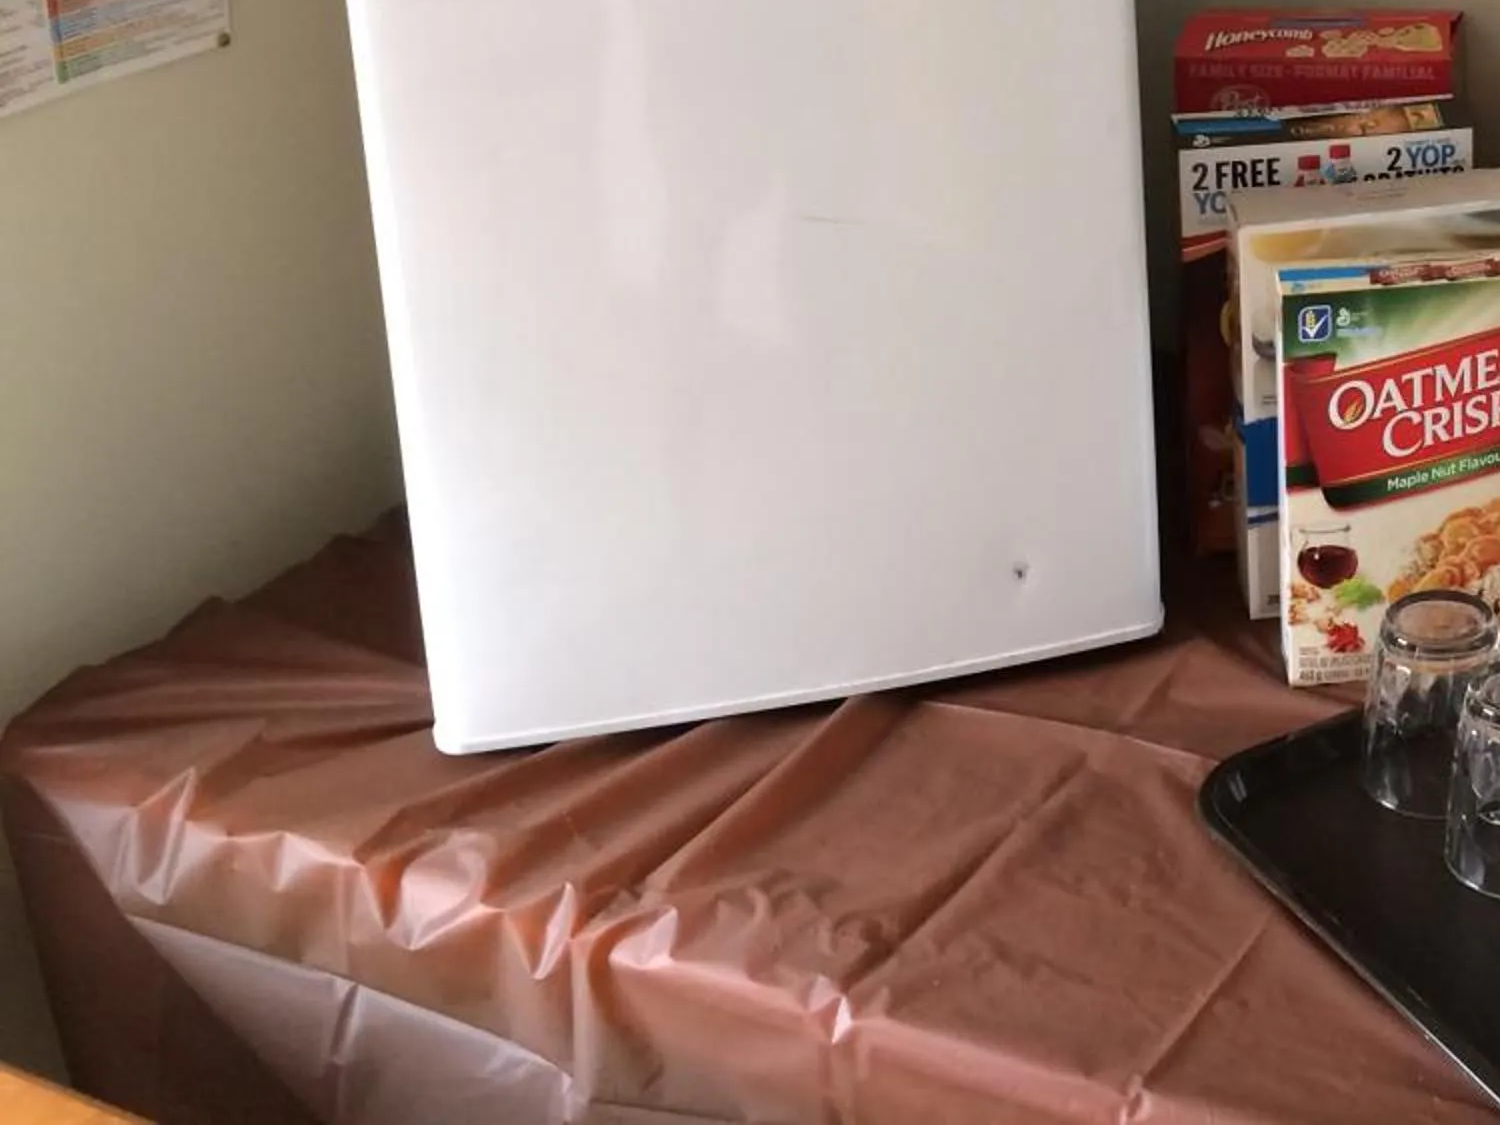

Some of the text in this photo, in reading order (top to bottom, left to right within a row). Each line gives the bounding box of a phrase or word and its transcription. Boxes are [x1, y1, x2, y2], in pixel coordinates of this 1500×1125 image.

[1205, 27, 1313, 52] Honeycomb
[1387, 145, 1455, 171] 2 YOP
[1192, 158, 1281, 190] 2 FREE
[1386, 472, 1429, 493] Maple
[1431, 464, 1456, 480] Nut
